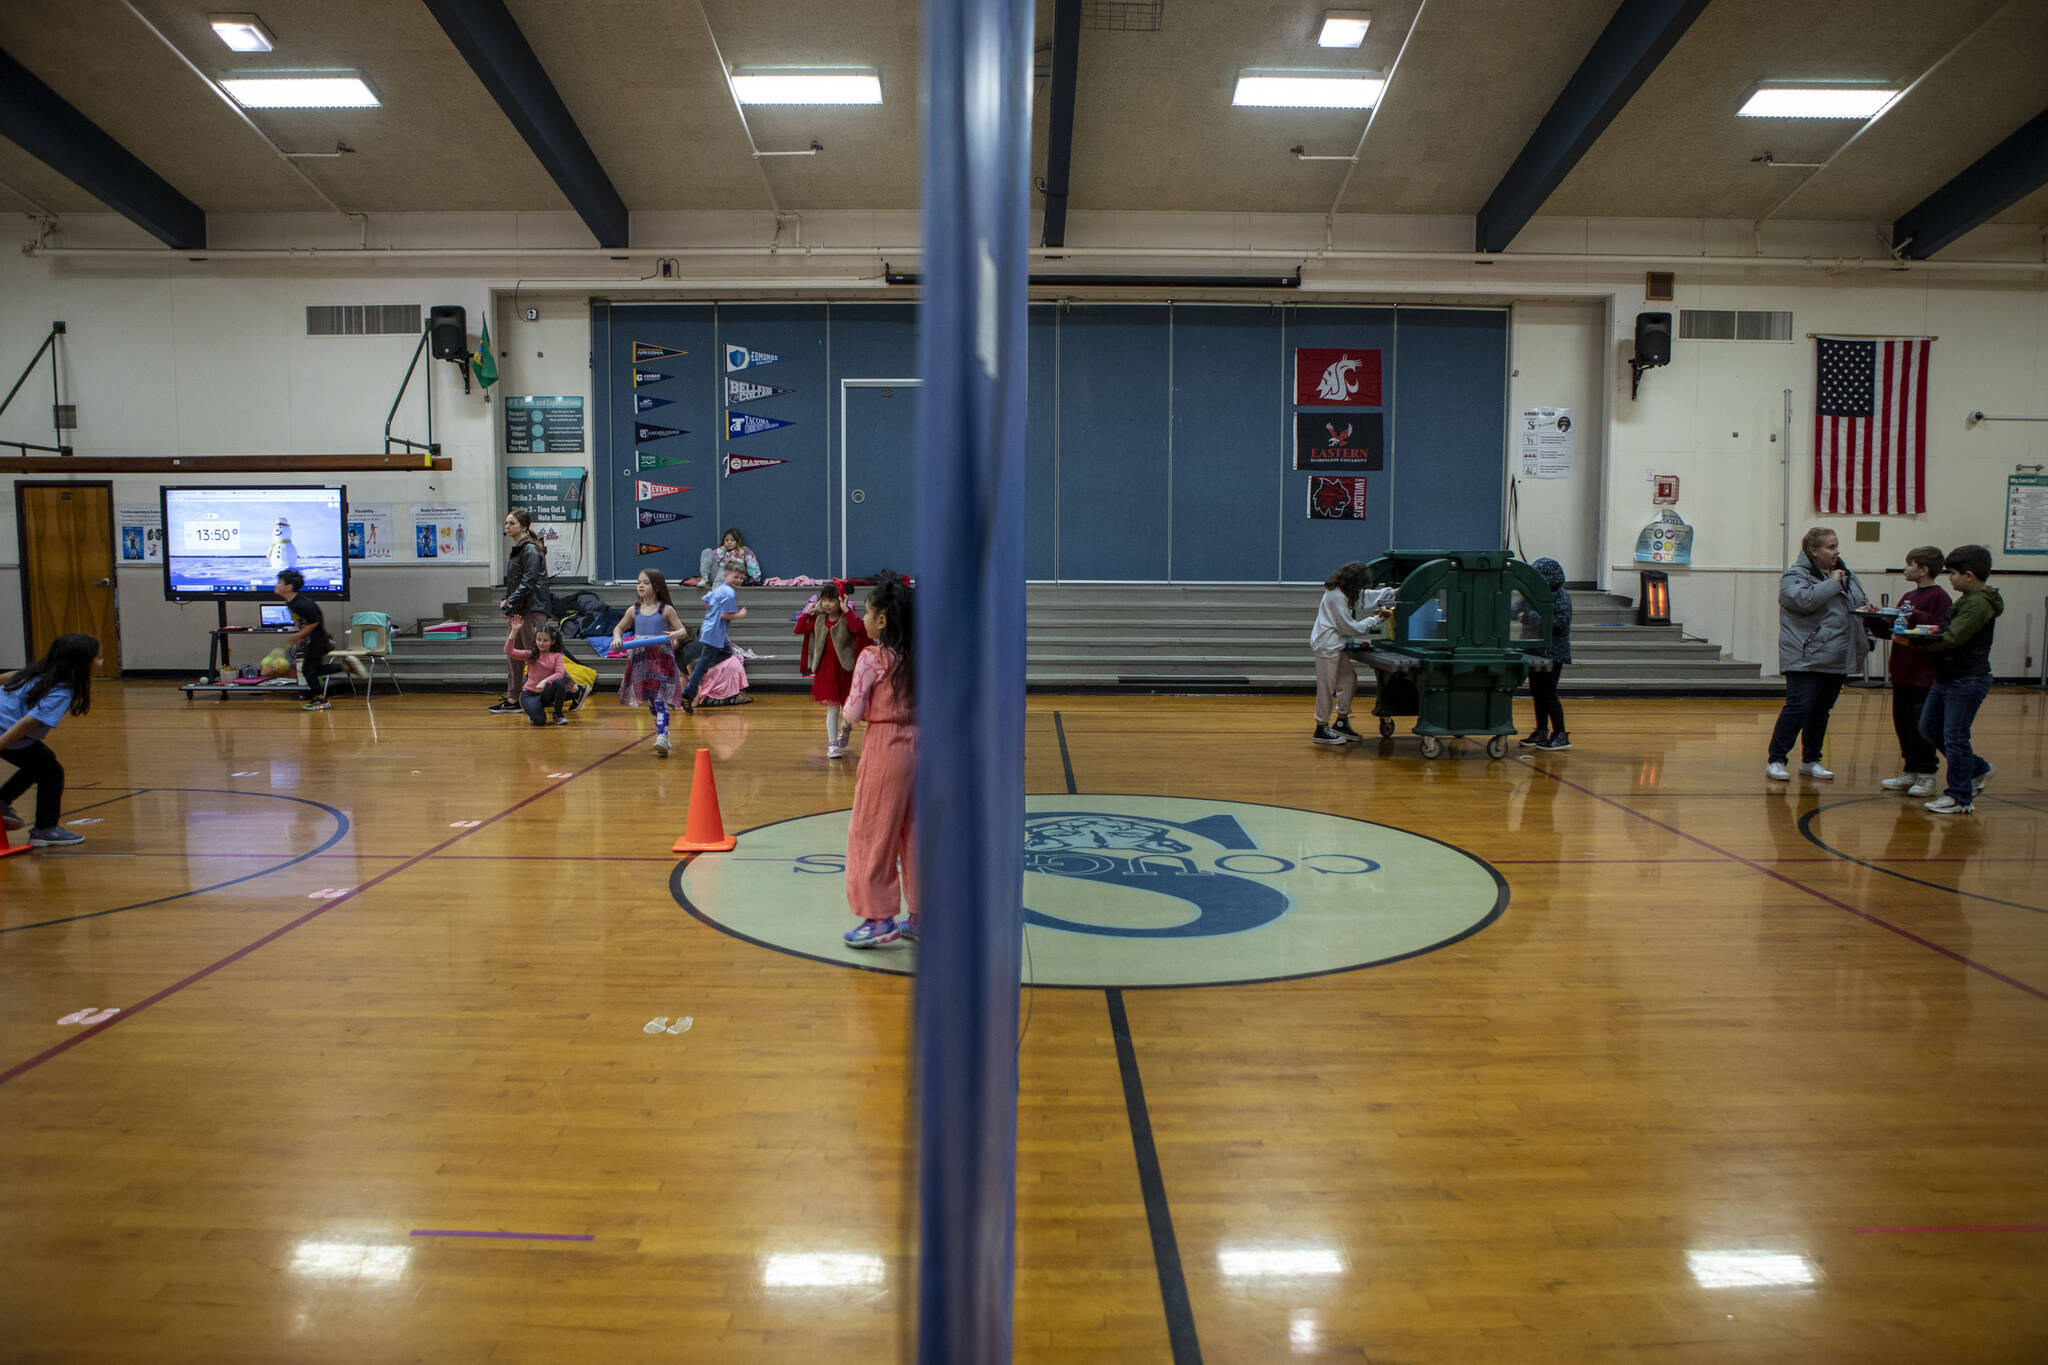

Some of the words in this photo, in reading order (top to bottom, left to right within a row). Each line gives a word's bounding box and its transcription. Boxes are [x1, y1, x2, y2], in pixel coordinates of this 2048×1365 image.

[750, 350, 779, 362] EDMONDS
[744, 415, 770, 425] TACOMA
[1311, 448, 1368, 458] EASTERN
[534, 482, 558, 491] Warning
[536, 494, 559, 502] Refocus
[1353, 482, 1365, 518] WILDCATS
[196, 528, 231, 542] 13:50
